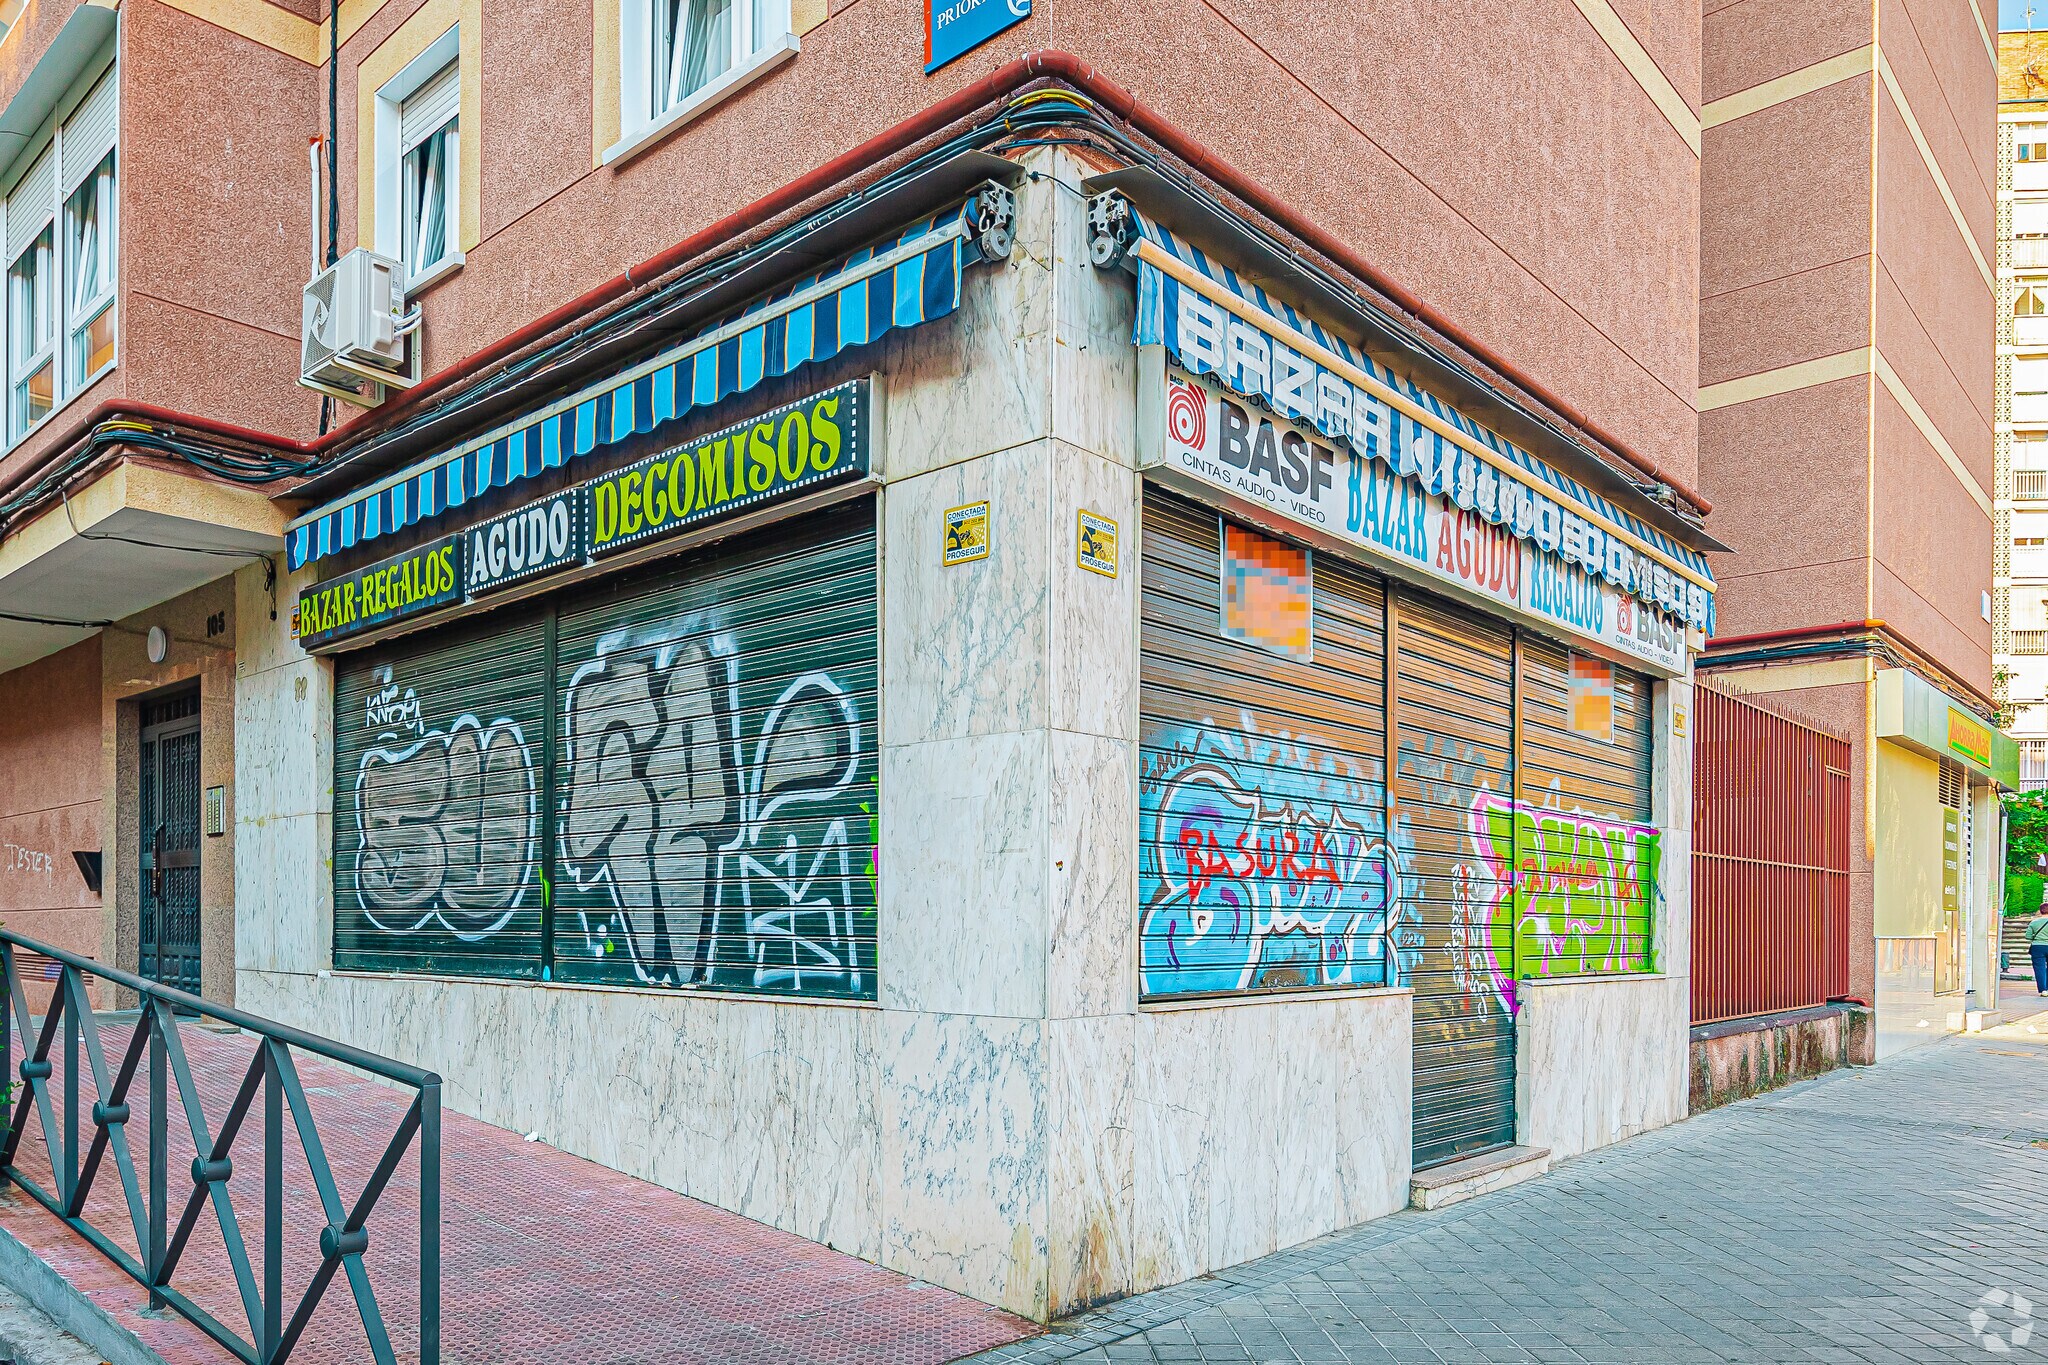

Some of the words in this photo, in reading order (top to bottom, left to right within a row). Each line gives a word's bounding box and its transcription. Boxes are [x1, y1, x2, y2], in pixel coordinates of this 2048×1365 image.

[937, 0, 987, 30] PRIOR
[594, 395, 842, 545] DECOMISOS
[1220, 396, 1334, 503] BASF
[1182, 452, 1232, 483] CINTAS
[1236, 476, 1276, 502] AUDIO
[1289, 501, 1326, 524] VIDEO
[947, 505, 986, 520] CONECTADA
[1081, 514, 1115, 532] CONECTADA
[470, 499, 569, 585] AGUDO
[946, 545, 986, 560] PROSEGUR
[1346, 450, 1428, 563] BAZAR
[1436, 495, 1520, 600] AGUDO
[1530, 545, 1604, 635] REGALOS
[1080, 555, 1115, 573] PROSEGUR
[300, 544, 455, 638] BAZAR-REGALOS
[206, 610, 226, 639] 105
[1637, 599, 1684, 654] BASF
[1615, 634, 1636, 651] CINTAS
[1636, 644, 1653, 658] AUDIO
[1658, 652, 1675, 666] VIDEO
